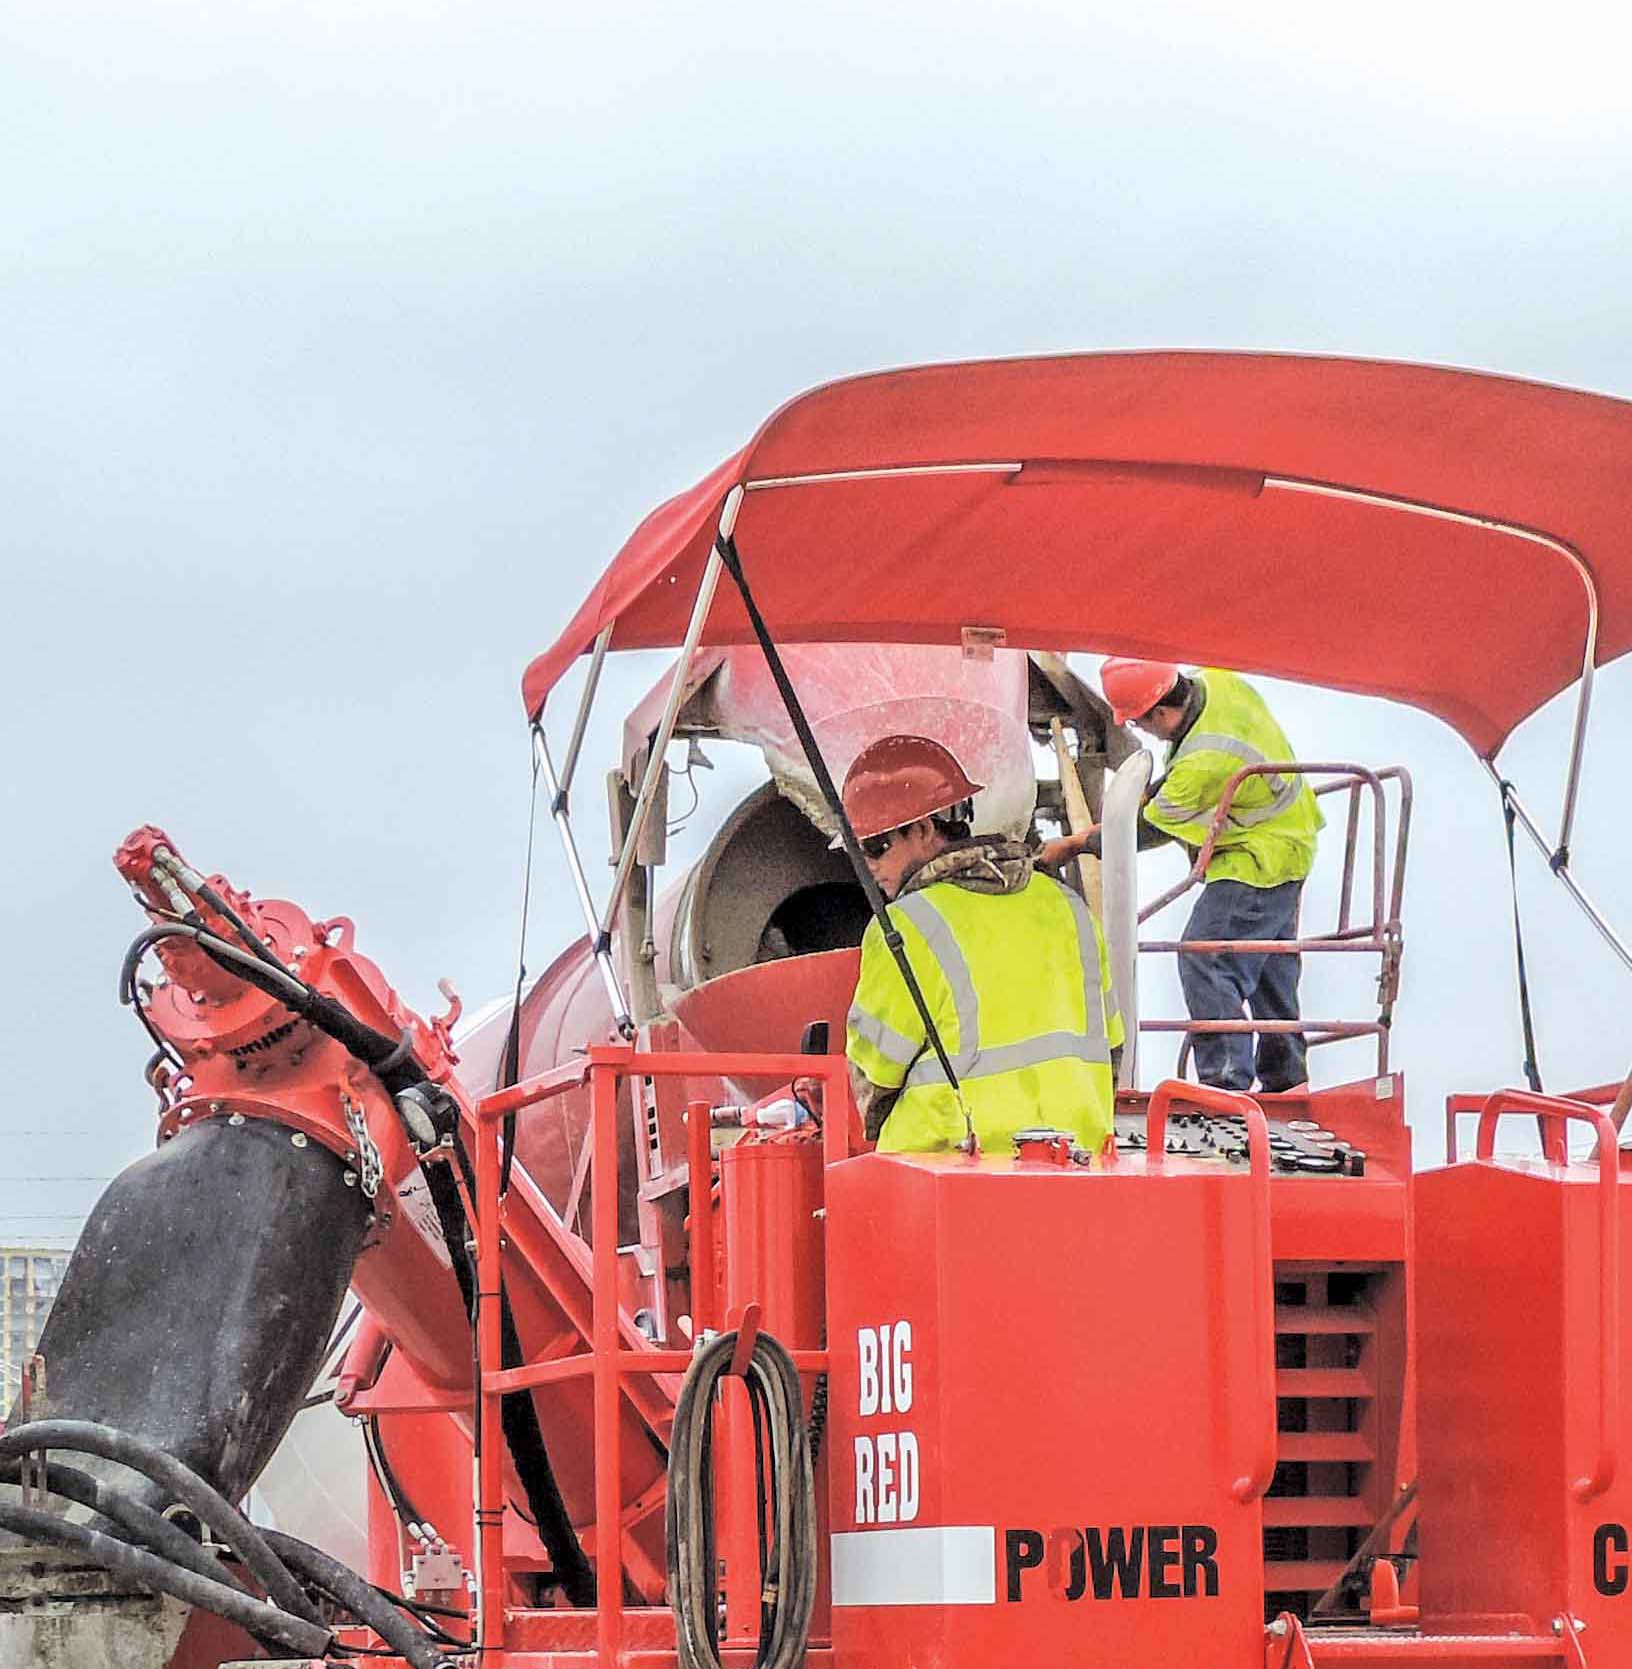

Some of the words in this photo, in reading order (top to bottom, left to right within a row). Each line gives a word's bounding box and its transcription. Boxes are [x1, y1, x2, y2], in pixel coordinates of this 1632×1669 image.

[858, 1320, 913, 1416] BIG
[854, 1432, 919, 1524] RED
[1005, 1525, 1219, 1602] POWER
